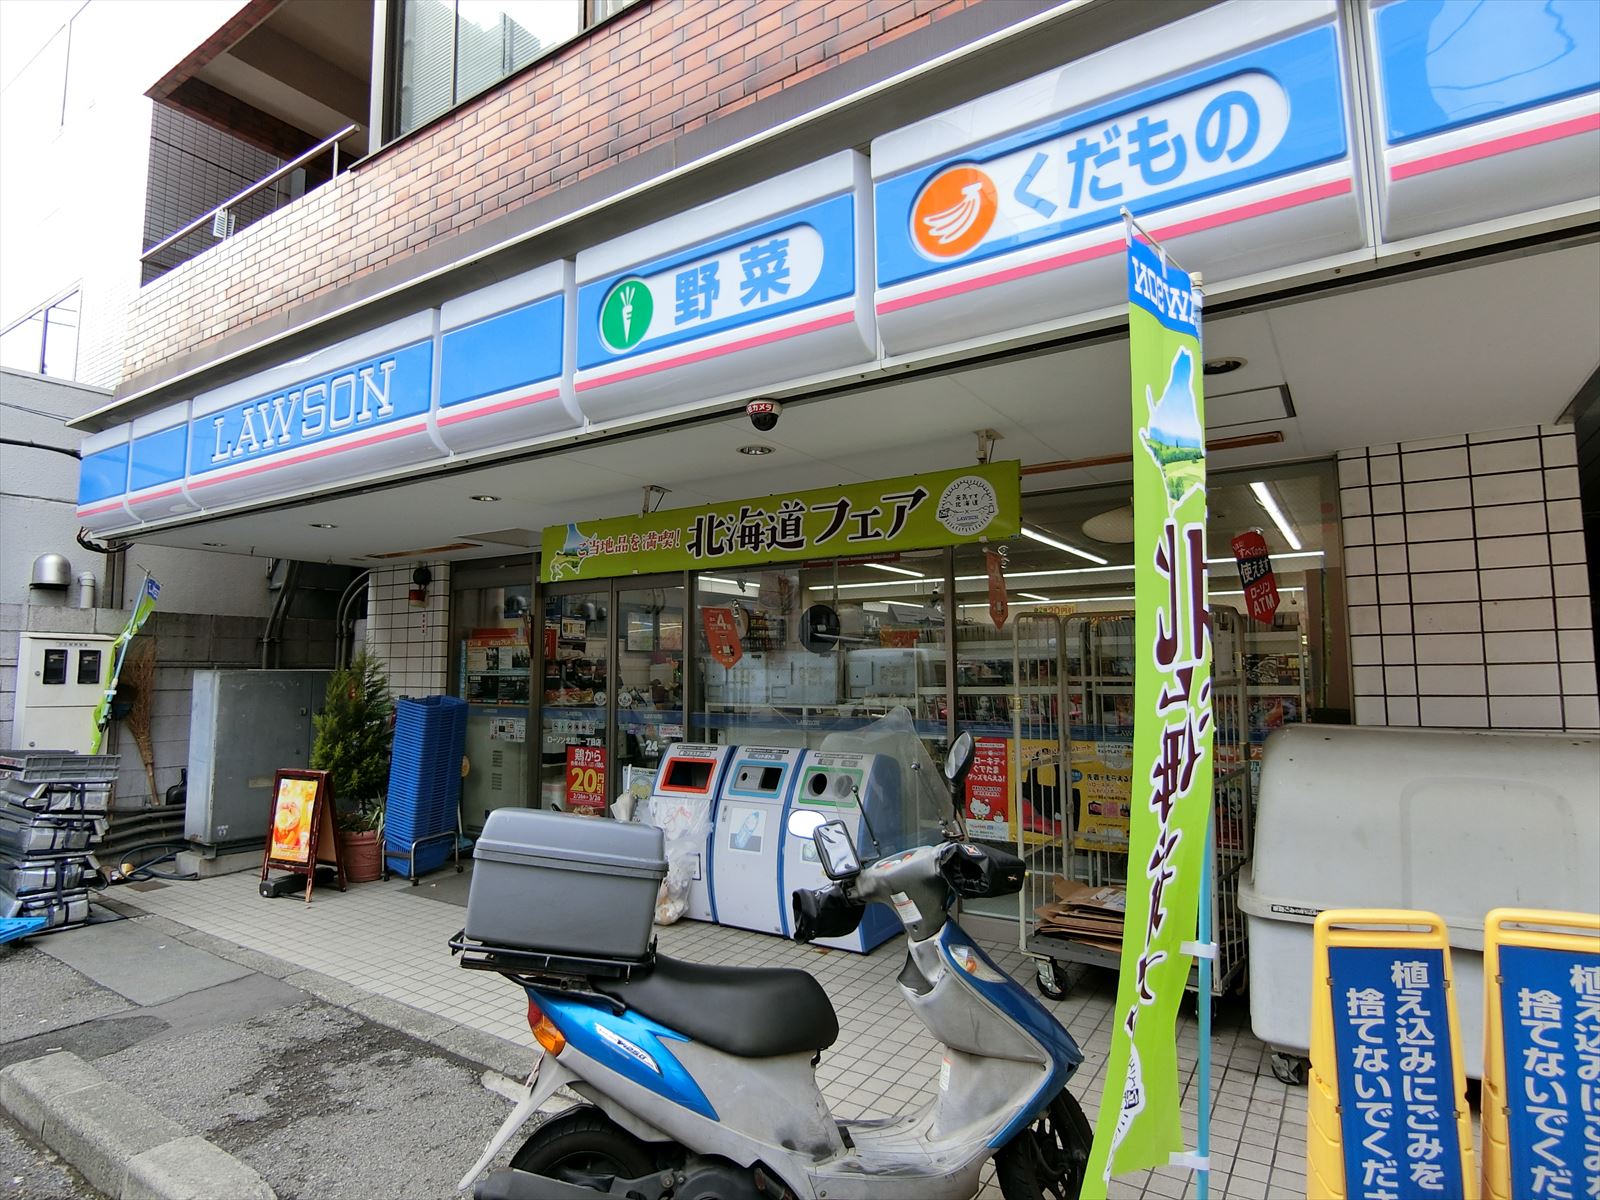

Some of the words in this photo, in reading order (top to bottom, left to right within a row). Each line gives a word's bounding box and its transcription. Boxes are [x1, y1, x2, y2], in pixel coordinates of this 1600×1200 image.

[1013, 90, 1261, 219] くだもの
[674, 238, 792, 326] 野菜
[212, 361, 395, 462] LAWSON
[686, 486, 929, 559] 北海道フェア
[1240, 557, 1270, 584] 使えます
[1250, 582, 1271, 599] ローソン
[1253, 594, 1276, 617] ATM
[1346, 987, 1400, 1200] 捨てないでくだ
[1390, 960, 1446, 1190] 植え込みにごみを
[1516, 987, 1573, 1200] 捨てないでくだ
